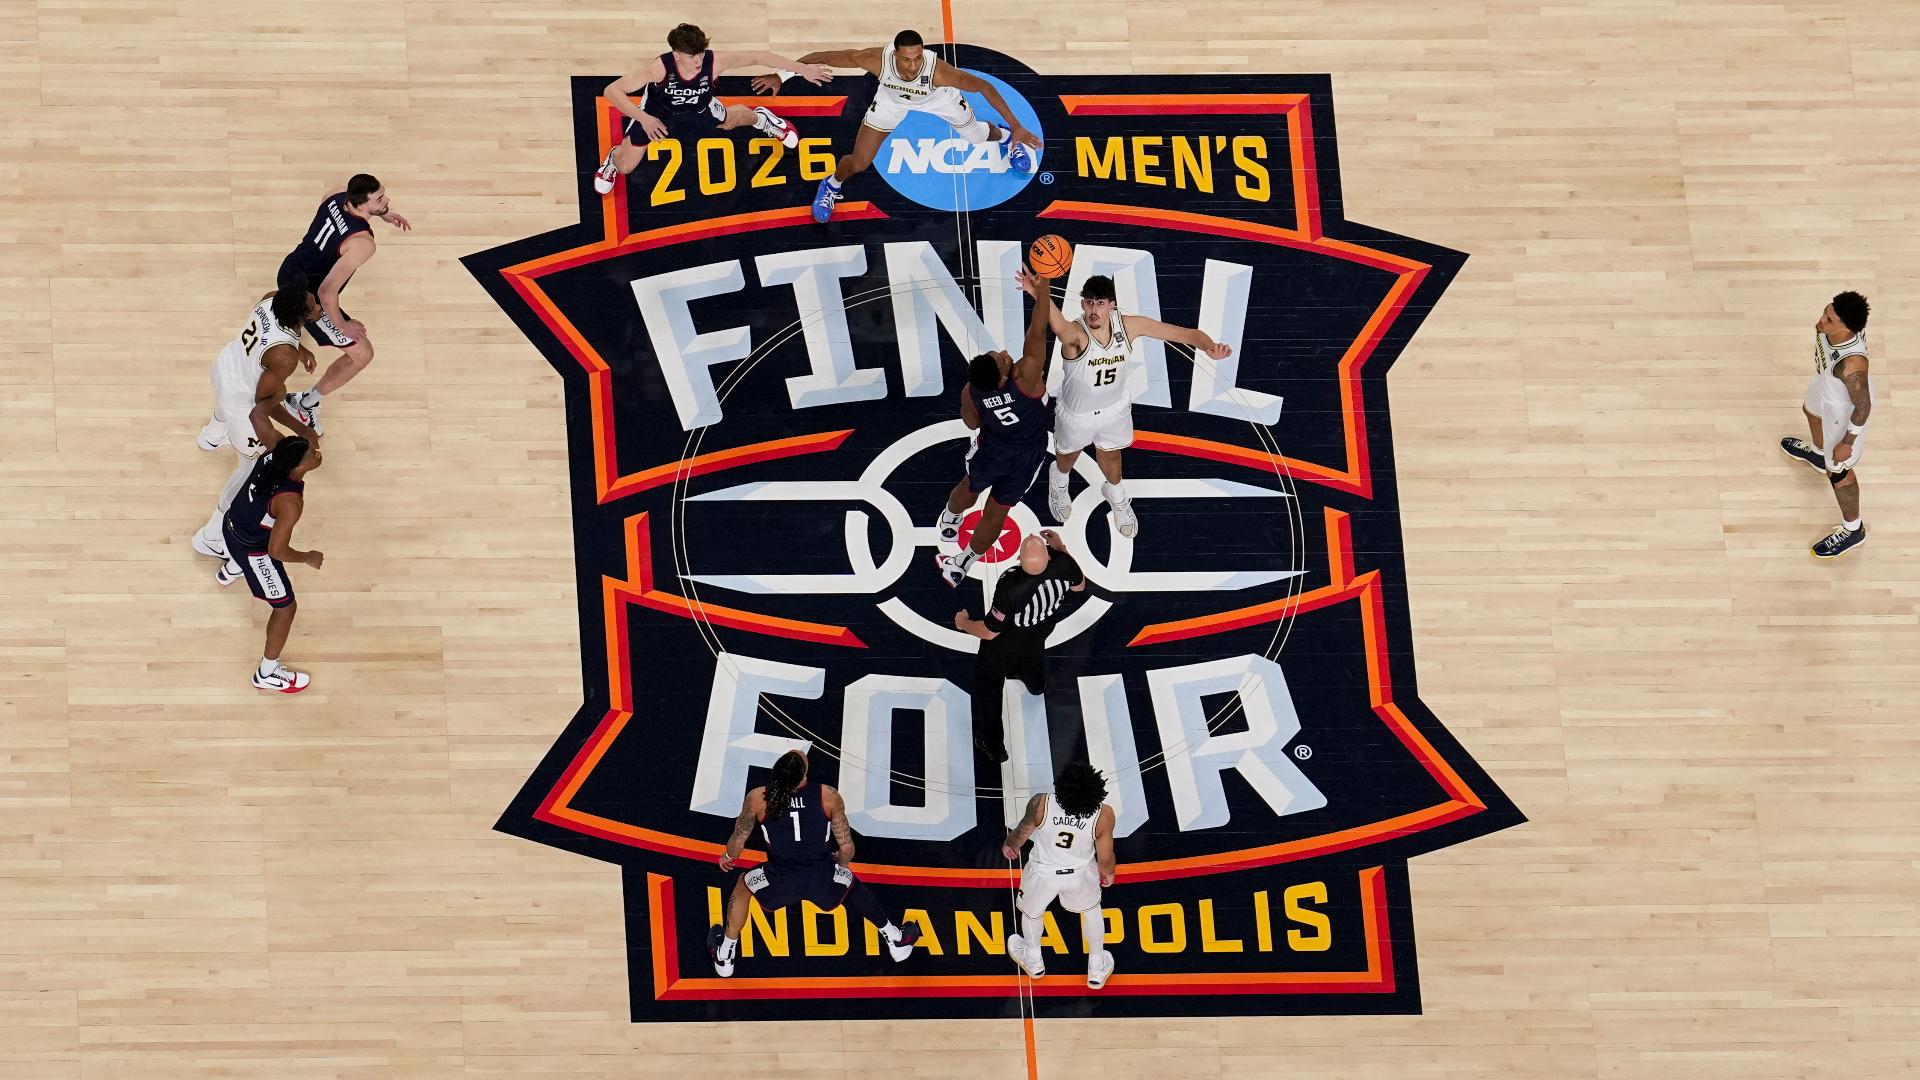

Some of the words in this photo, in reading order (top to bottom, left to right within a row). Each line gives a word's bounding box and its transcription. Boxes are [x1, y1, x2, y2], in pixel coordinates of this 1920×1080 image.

[664, 86, 710, 96] UCONN
[671, 96, 700, 106] 24
[883, 83, 928, 96] MICHIGAN
[647, 138, 837, 207] 2026
[1075, 136, 1271, 203] MEN'S
[327, 199, 349, 235] KARABAN
[313, 217, 335, 252] 11
[254, 306, 271, 335] JOHNSON
[241, 320, 258, 356] 21
[630, 240, 1284, 431] FINAL
[1087, 354, 1126, 367] MICHIGAN
[1093, 367, 1117, 387] 15
[982, 395, 1004, 409] REED
[1003, 392, 1016, 405] JR.
[993, 406, 1020, 426] 5
[256, 557, 280, 597] HUSKIES
[689, 652, 1328, 842] FOUR
[788, 796, 806, 809] ALL
[789, 810, 802, 842] 1
[1052, 816, 1087, 830] CADEAU
[1055, 831, 1075, 849] 3
[707, 881, 1332, 958] INDIANAPOLIS
